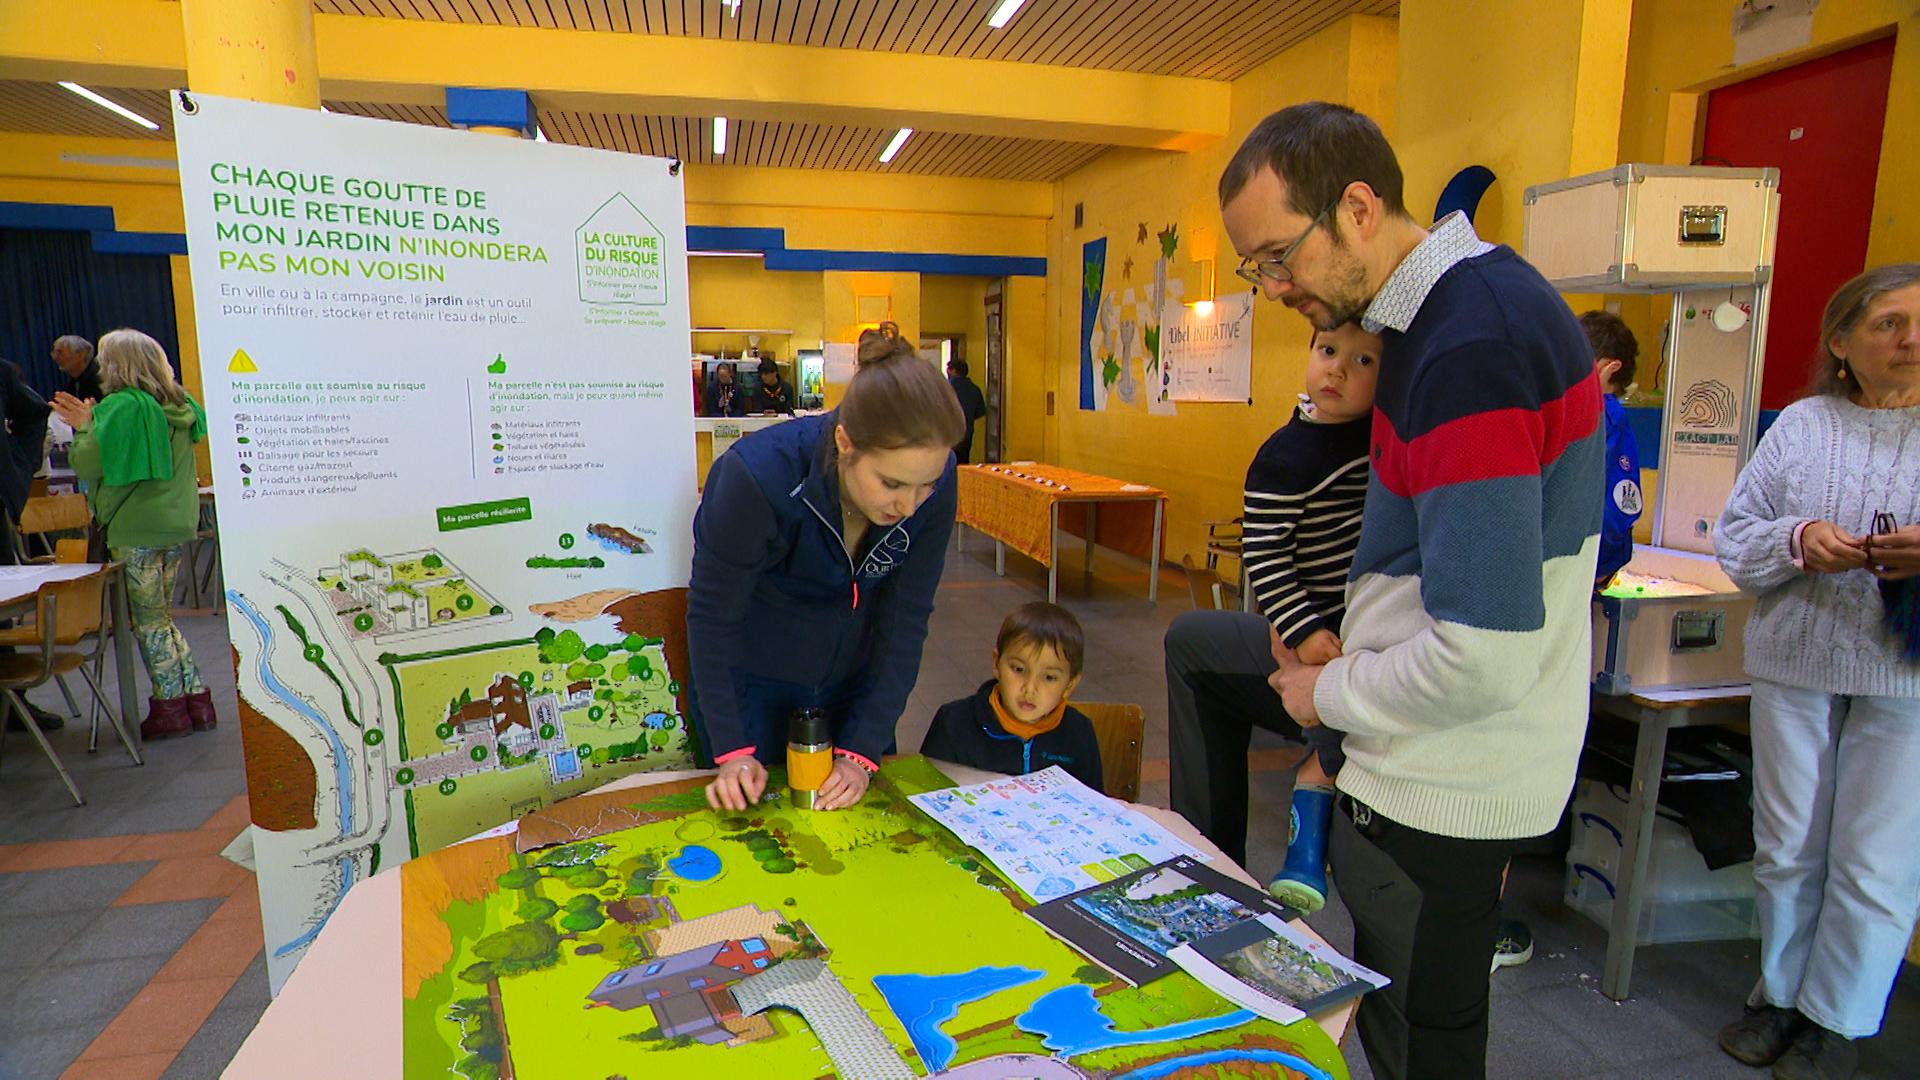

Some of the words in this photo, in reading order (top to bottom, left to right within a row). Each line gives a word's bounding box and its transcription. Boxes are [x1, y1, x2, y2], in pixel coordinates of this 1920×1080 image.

[210, 163, 335, 195] CHAQUE
[344, 178, 448, 206] GOUTTE
[456, 189, 486, 209] DE
[213, 192, 296, 218] PLUIE
[305, 201, 425, 230] RETENUE
[433, 213, 501, 236] DANS
[216, 221, 286, 246] MON
[294, 227, 390, 254] JARDIN
[400, 235, 548, 264] N'INONDERA
[584, 231, 600, 244] LA
[604, 233, 657, 249] CULTURE
[585, 247, 606, 262] DU
[609, 249, 658, 266] RISQUE
[219, 251, 277, 273] PAS
[286, 255, 350, 277] MON
[357, 259, 445, 283] VOISIN
[585, 265, 659, 280] D'INONDATION
[221, 283, 241, 296] En
[245, 284, 275, 298] ville
[279, 288, 298, 300] ou
[303, 288, 311, 300] à
[315, 289, 328, 301] la
[410, 293, 421, 304] le
[424, 293, 463, 307] jardin
[466, 297, 485, 307] est
[488, 298, 504, 308] un
[506, 297, 532, 308] outil
[223, 303, 257, 316] pour
[322, 305, 371, 320] stocker
[376, 309, 390, 320] et
[393, 310, 435, 321] retenir
[438, 309, 467, 322] l'eau
[470, 311, 486, 322] de
[231, 381, 250, 391] Ma
[254, 381, 302, 392] parcelle
[305, 382, 323, 391] est
[326, 381, 374, 390] soumise
[393, 381, 426, 392] risque
[488, 381, 503, 390] Ma
[506, 381, 543, 391] parcelle
[588, 381, 624, 389] soumise
[639, 380, 665, 390] risque
[316, 394, 326, 404] je
[329, 394, 357, 404] peux
[359, 393, 380, 404] agir
[383, 394, 400, 402] sur
